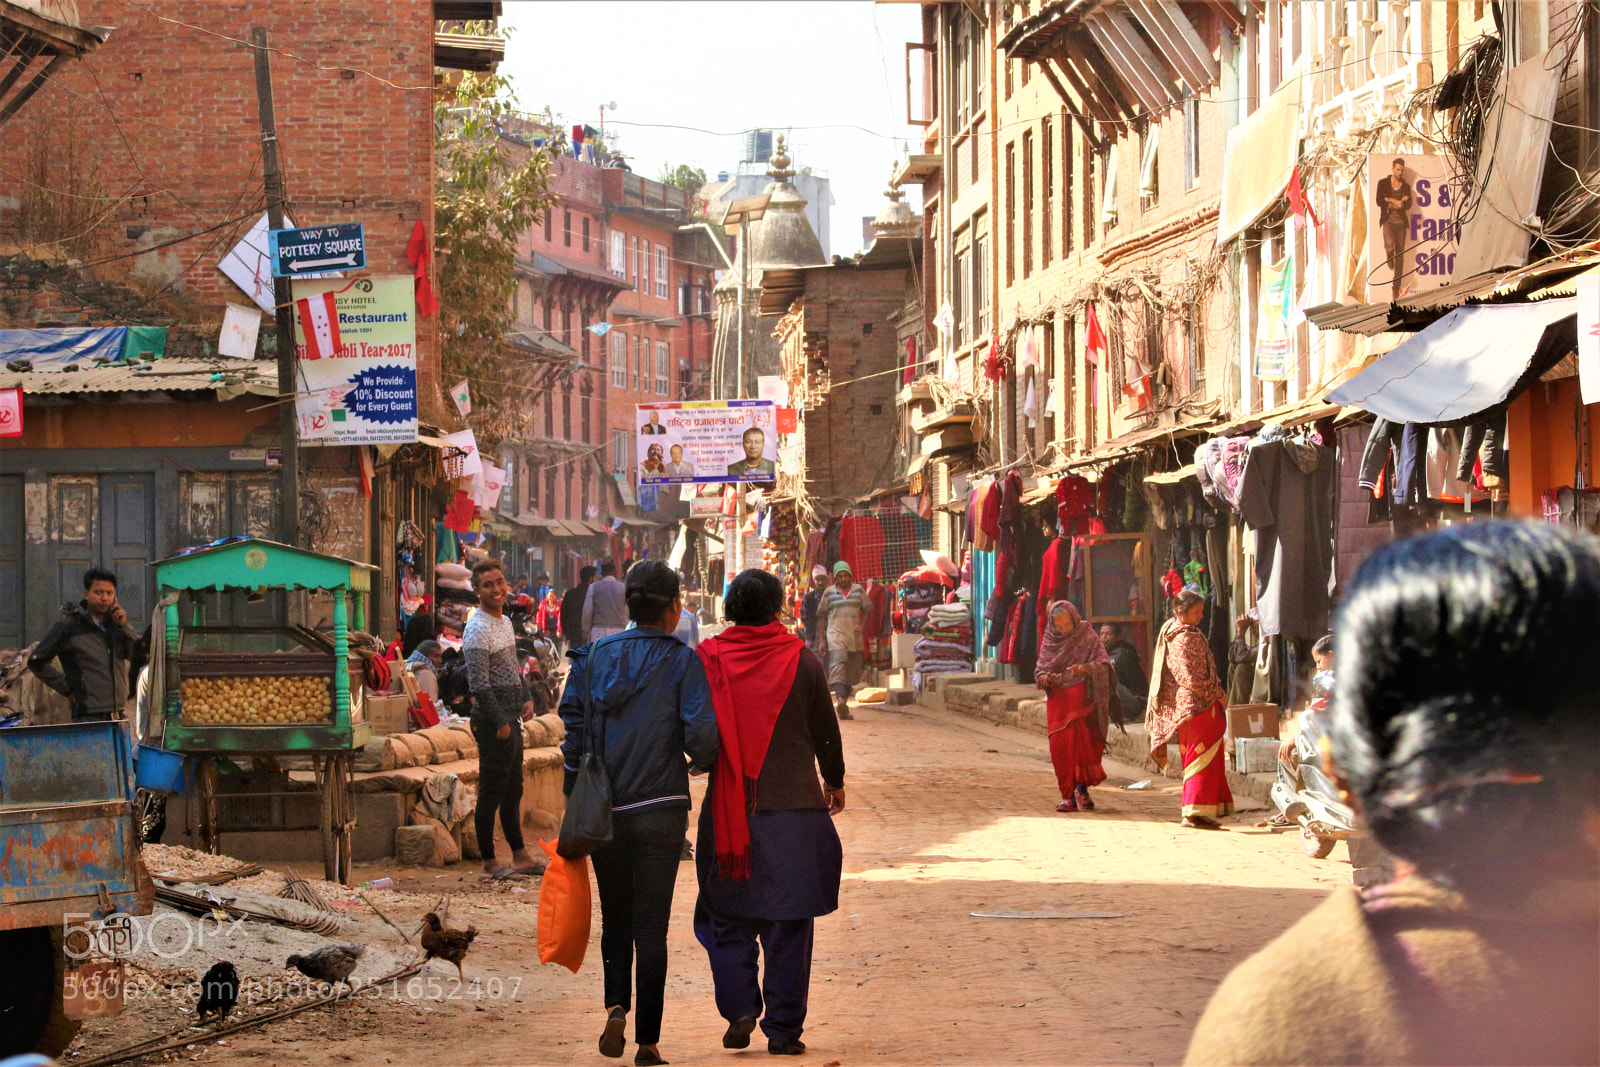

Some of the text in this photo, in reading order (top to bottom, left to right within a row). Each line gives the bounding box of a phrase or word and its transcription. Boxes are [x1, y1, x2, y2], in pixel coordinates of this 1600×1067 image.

[1415, 179, 1432, 207] S
[300, 228, 339, 240] WAY TO
[279, 238, 363, 258] POTTERY SQUARE
[338, 312, 408, 324] Restaurant
[359, 342, 412, 359] Year-2017
[362, 377, 374, 386] We
[354, 388, 414, 400] 10% Discount
[356, 401, 412, 413] for Every Guest
